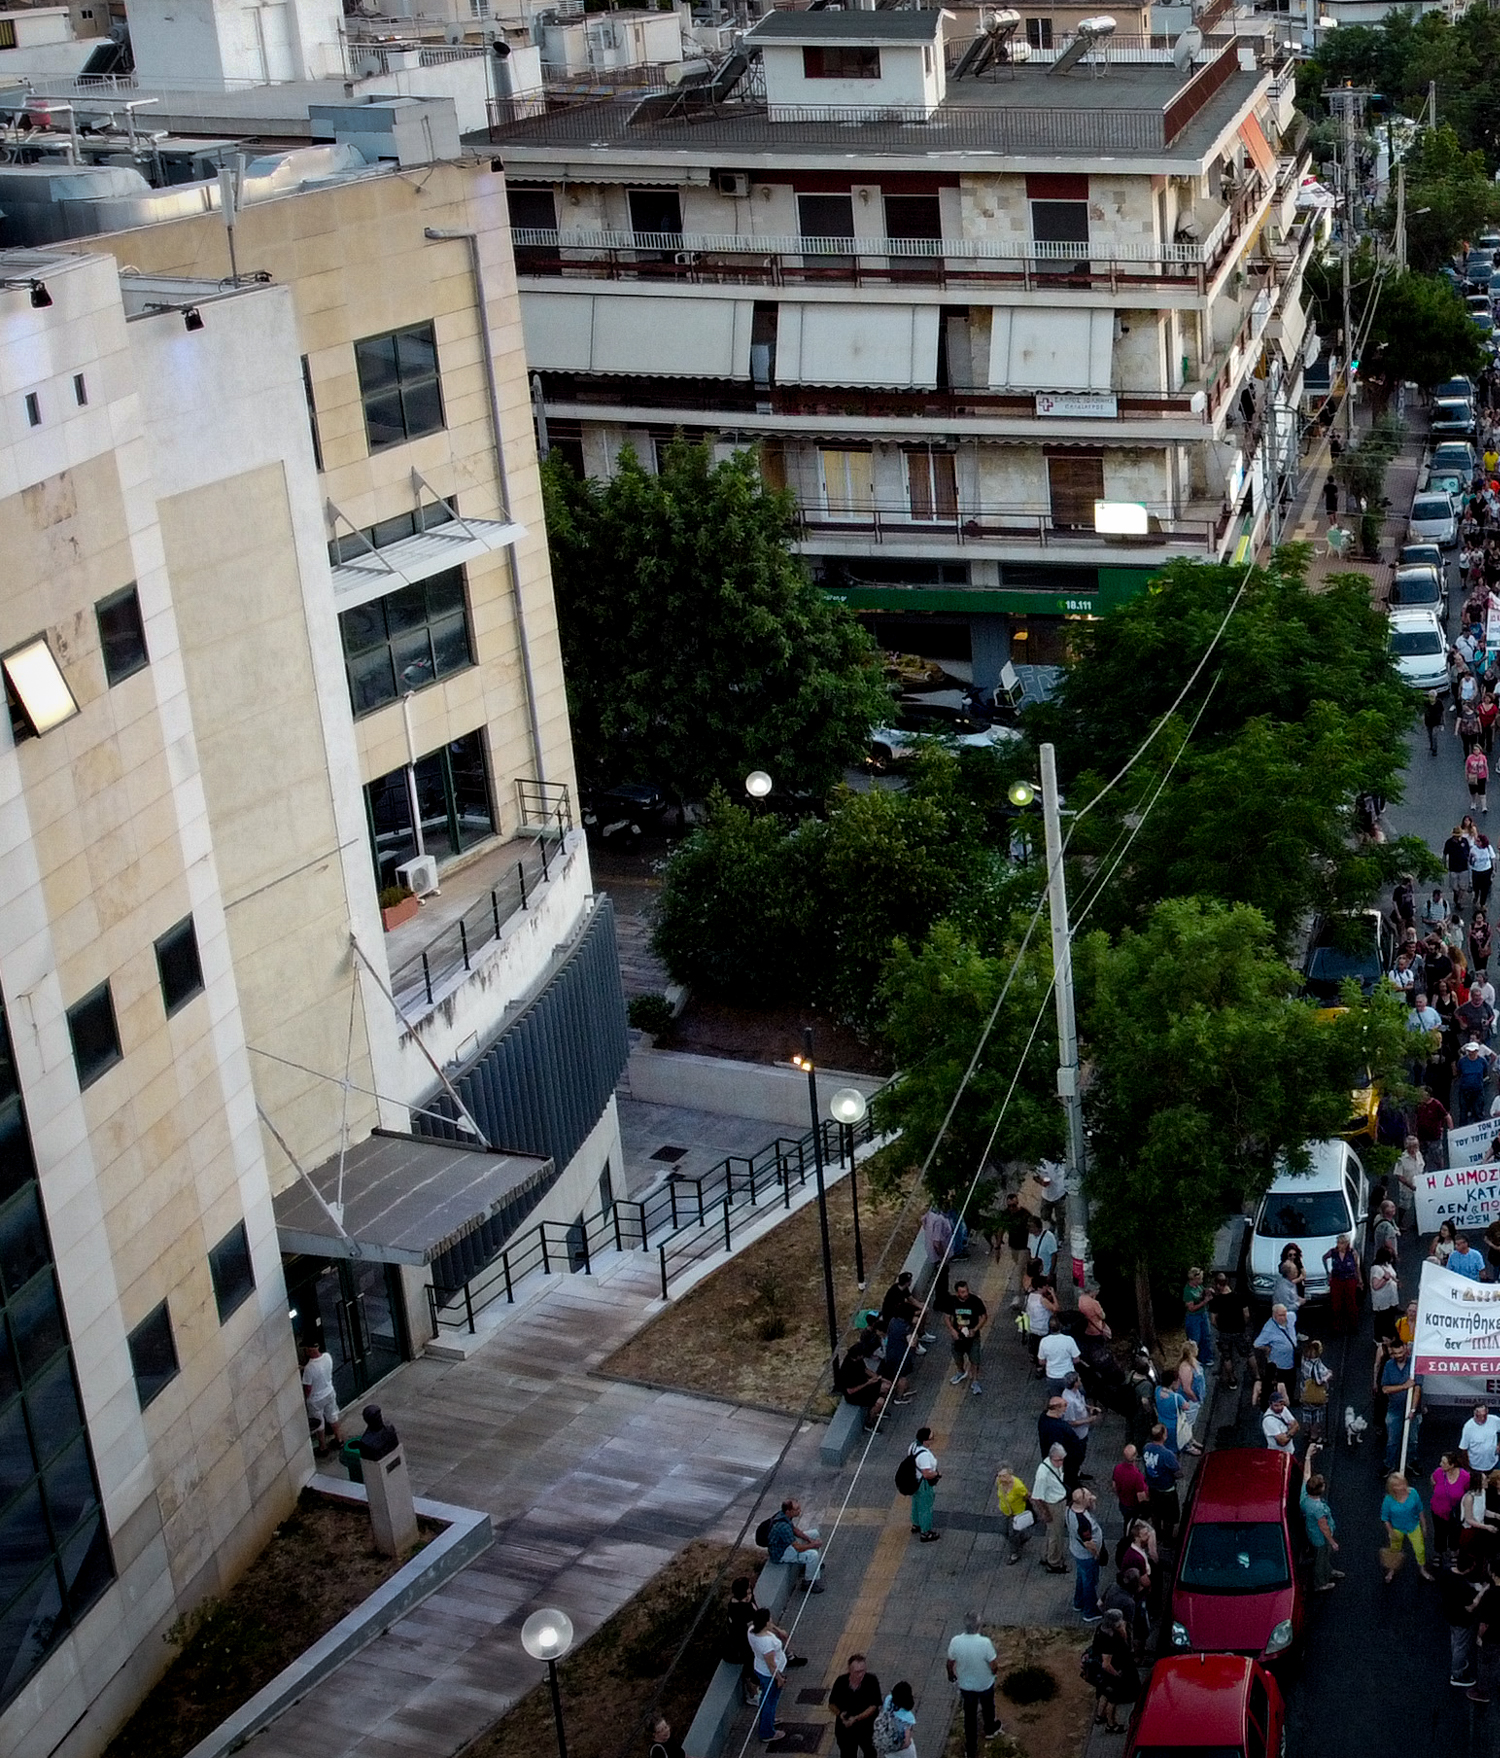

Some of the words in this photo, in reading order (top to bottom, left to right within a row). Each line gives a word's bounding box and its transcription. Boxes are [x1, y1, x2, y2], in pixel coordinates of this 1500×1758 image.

[1455, 1137, 1469, 1147] ΤΟΥ
[1471, 1133, 1488, 1143] ΤΟΤΕ
[1427, 1176, 1436, 1189] Η
[1437, 1203, 1468, 1214] ΔΕΝ
[1451, 1288, 1459, 1299] Η
[1444, 1337, 1462, 1350] δεν
